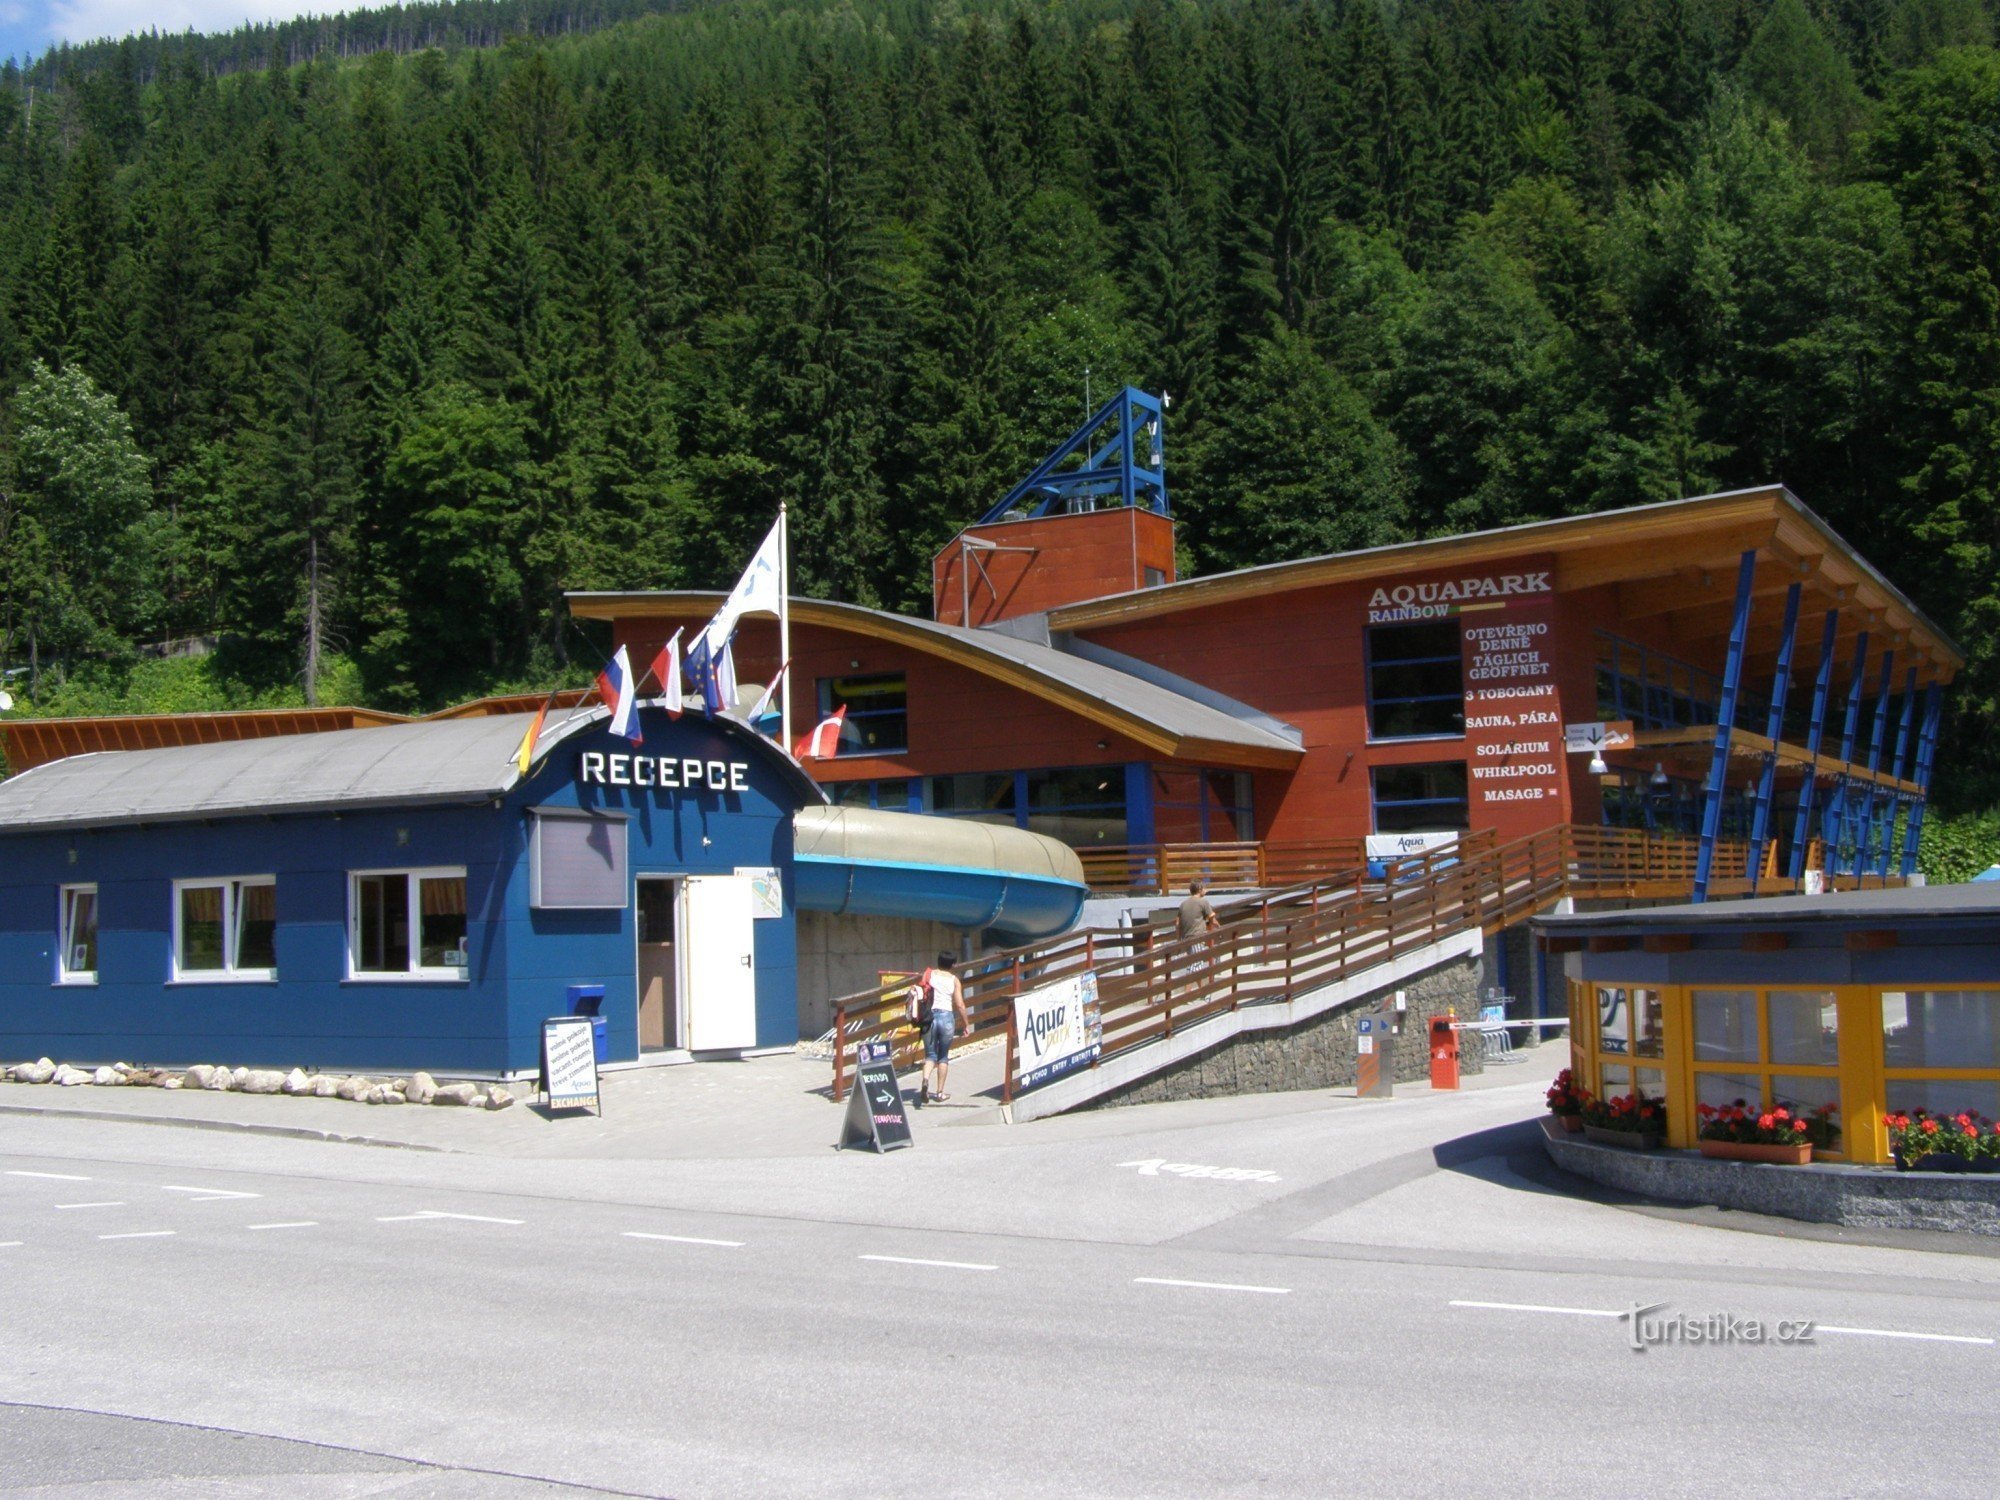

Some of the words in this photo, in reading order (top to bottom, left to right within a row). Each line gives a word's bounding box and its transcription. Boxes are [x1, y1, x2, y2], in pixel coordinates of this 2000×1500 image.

[1368, 572, 1552, 609] AQUAPARK
[1369, 604, 1450, 623] RAINBOW
[1465, 623, 1548, 641] OTEVŘENO
[1480, 637, 1531, 651] DENNĚ
[1473, 652, 1540, 667] TÄGLICH
[1465, 690, 1474, 701] 3
[1478, 685, 1554, 700] TOBOGANY
[1466, 715, 1516, 728] SAUNA,
[1519, 710, 1558, 725] PÁRA
[1477, 741, 1549, 756] SOLARIUM
[582, 752, 749, 791] RECEPCE
[1472, 764, 1556, 778] WHIRLPOOL
[1485, 788, 1543, 802] MASAGE
[1398, 837, 1424, 852] Aqua
[1024, 1005, 1065, 1056] Aqua
[1361, 1021, 1370, 1031] P
[551, 1097, 598, 1108] EXCHANGE
